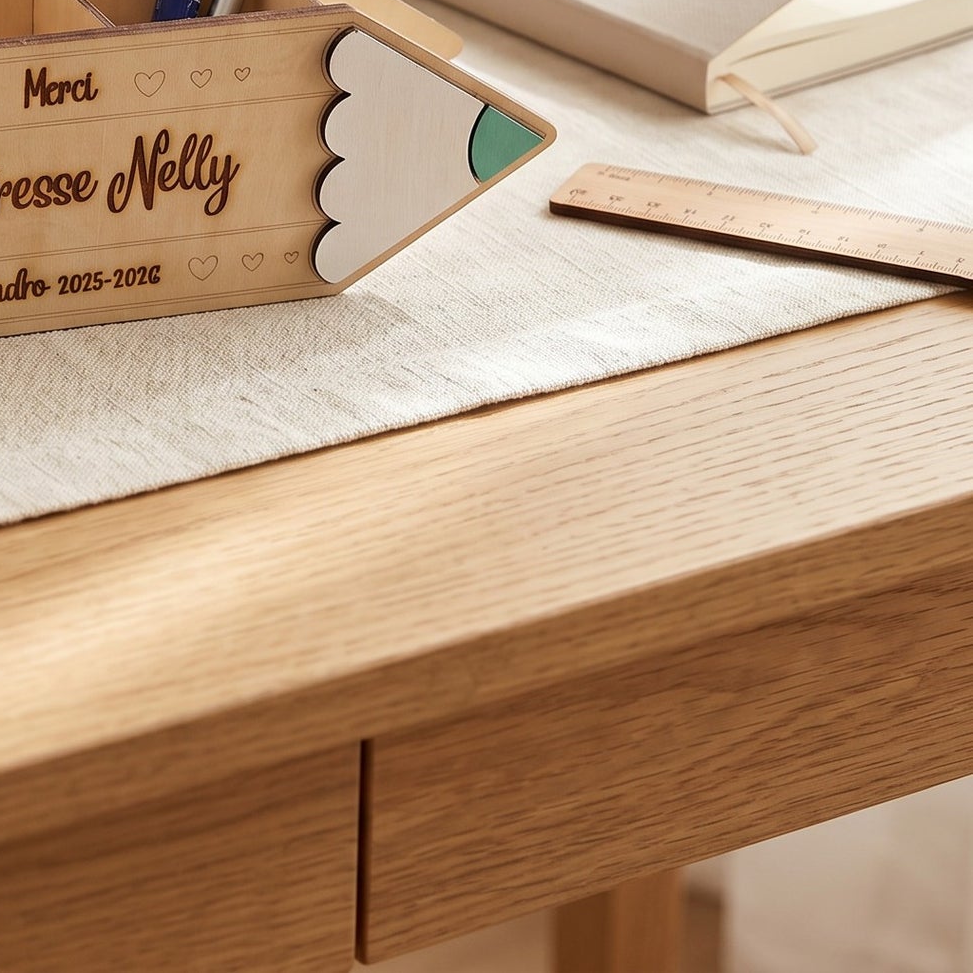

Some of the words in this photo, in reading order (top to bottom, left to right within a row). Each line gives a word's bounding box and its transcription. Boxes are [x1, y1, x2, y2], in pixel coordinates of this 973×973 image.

[24, 67, 99, 109] Merci
[107, 129, 240, 216] Nelly
[58, 265, 161, 295] 2025-2026
